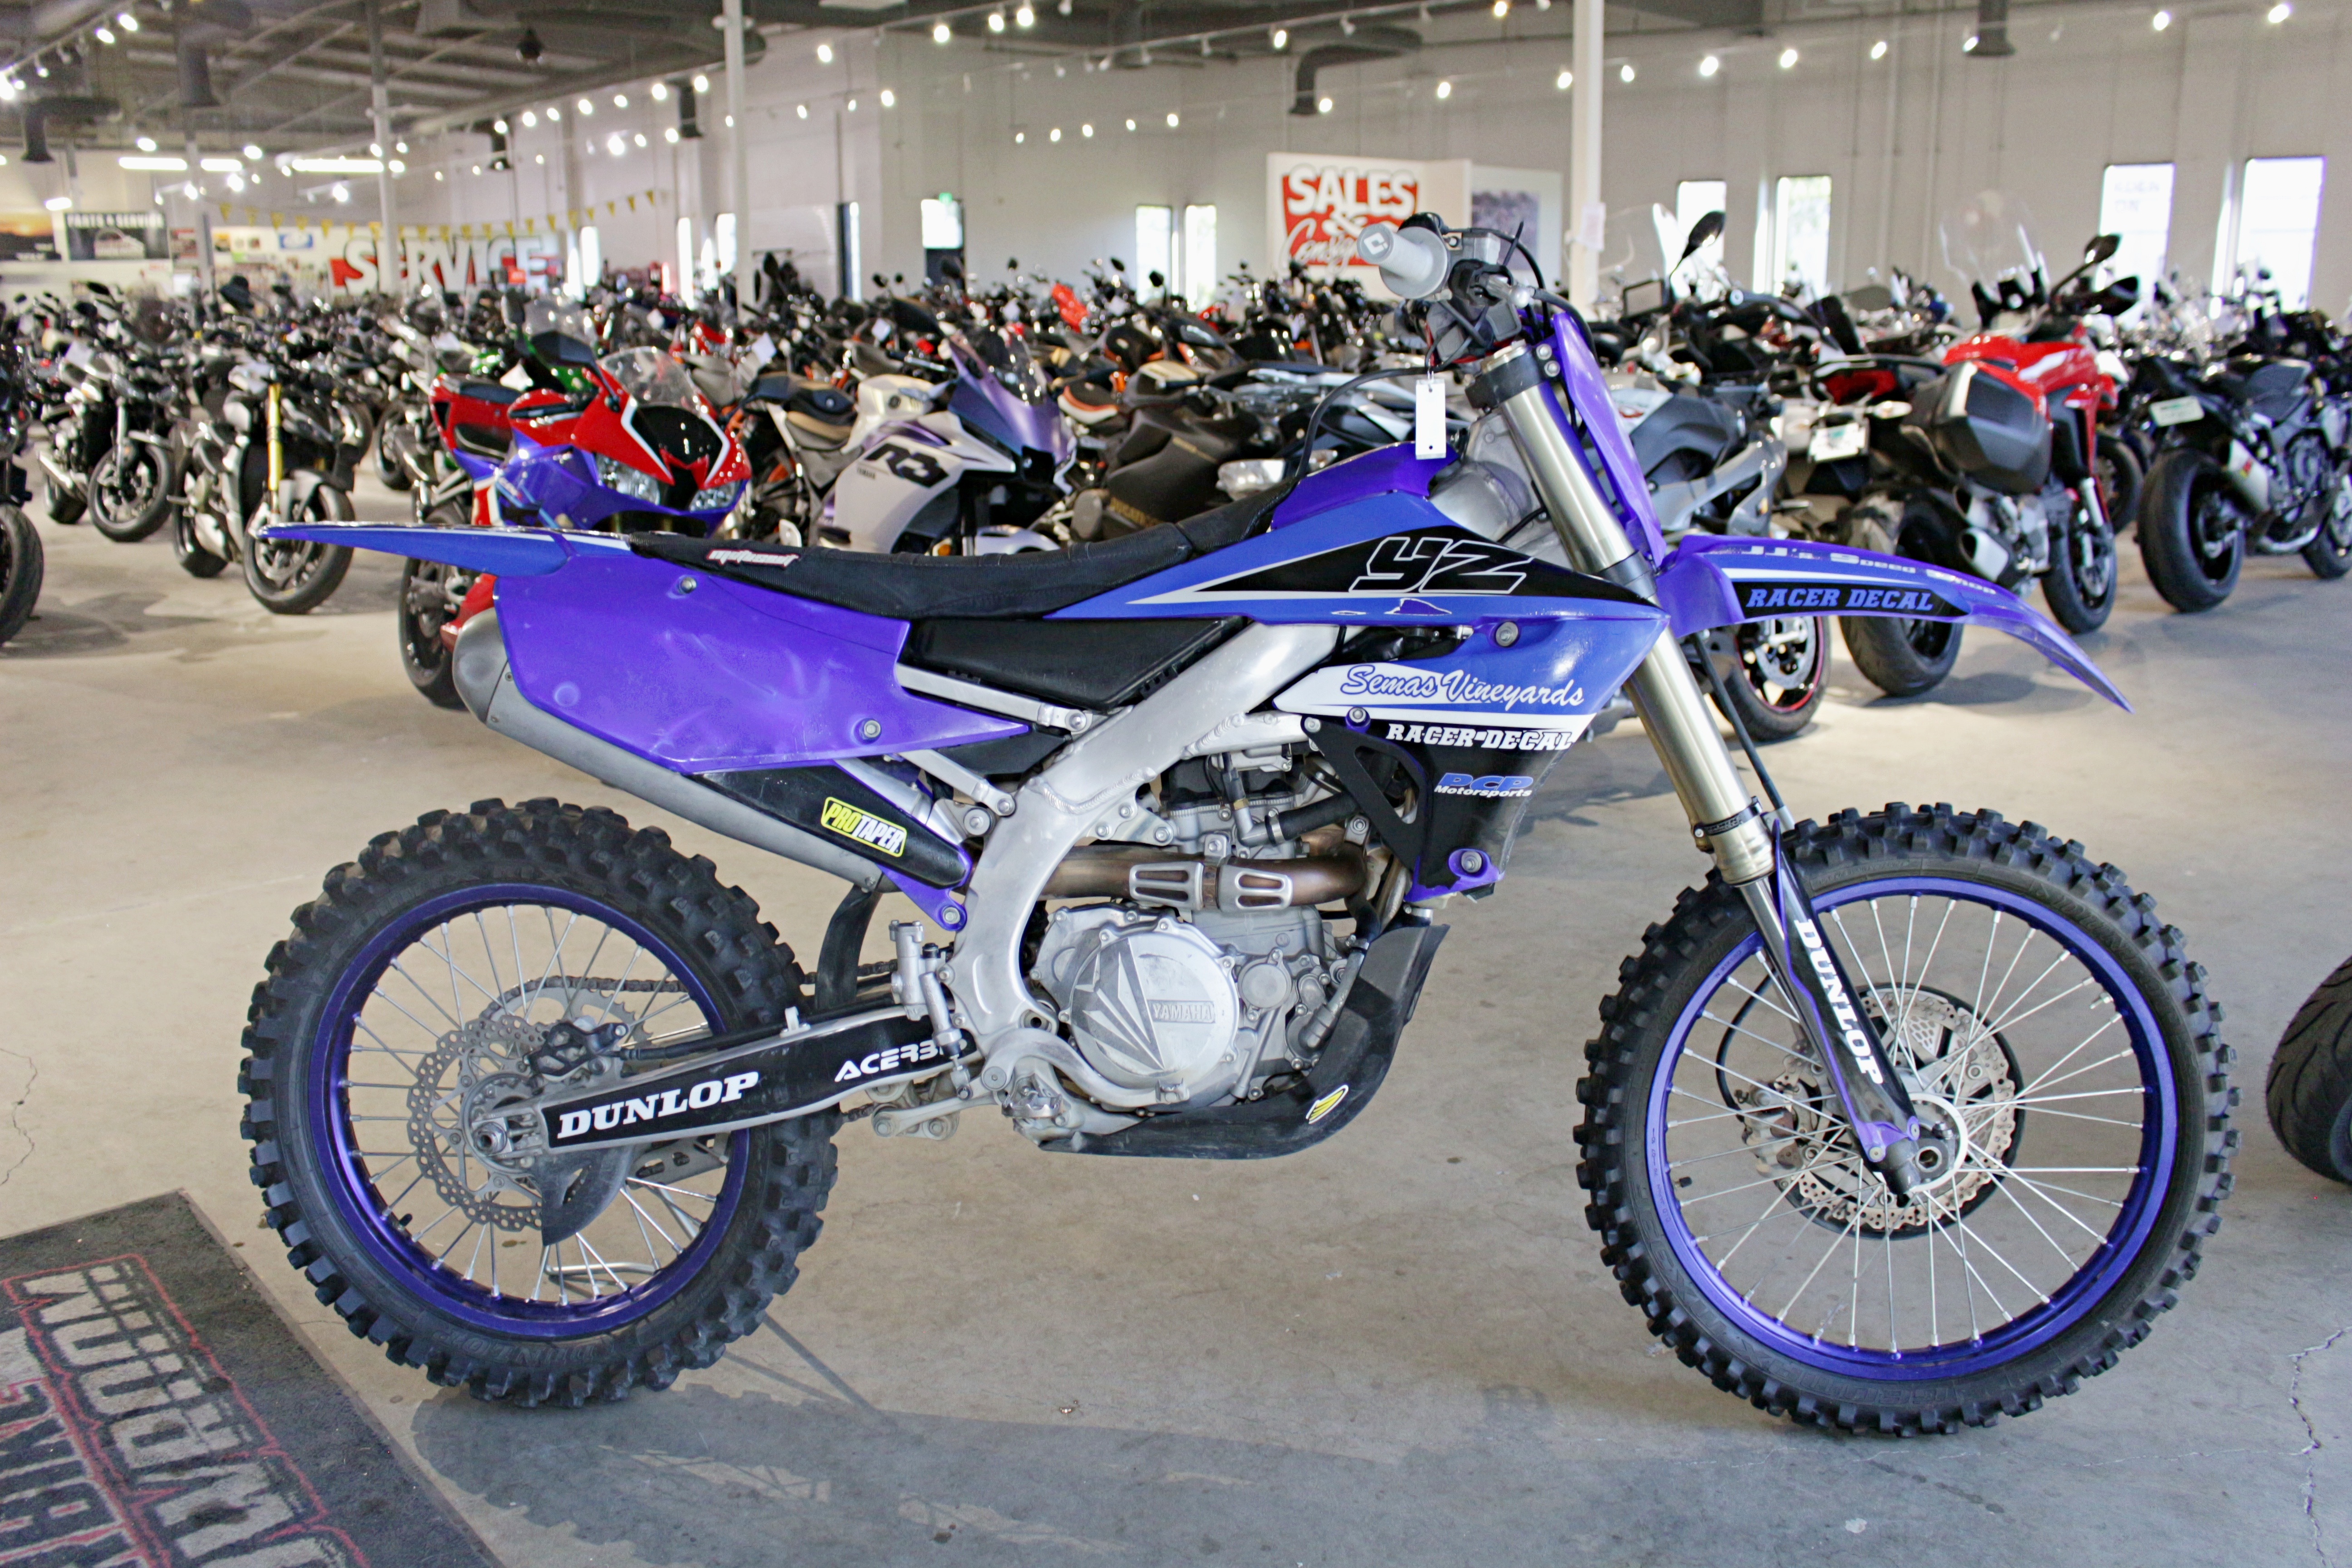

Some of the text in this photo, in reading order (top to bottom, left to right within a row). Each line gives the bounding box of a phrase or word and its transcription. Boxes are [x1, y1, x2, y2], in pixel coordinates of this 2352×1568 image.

[1287, 163, 1415, 220] SALES
[1348, 536, 1535, 594] YZ
[1745, 588, 1934, 611] RACER DECAL
[1341, 664, 1585, 712] Semas Vineyards
[1434, 785, 1532, 798] Motorsports
[1438, 772, 1534, 792] PCP
[1152, 1003, 1212, 1020] YAMAHA
[1794, 919, 1884, 1084] DUNLOP
[834, 1038, 968, 1083] ACERB
[557, 1071, 760, 1139] DUNLOP
